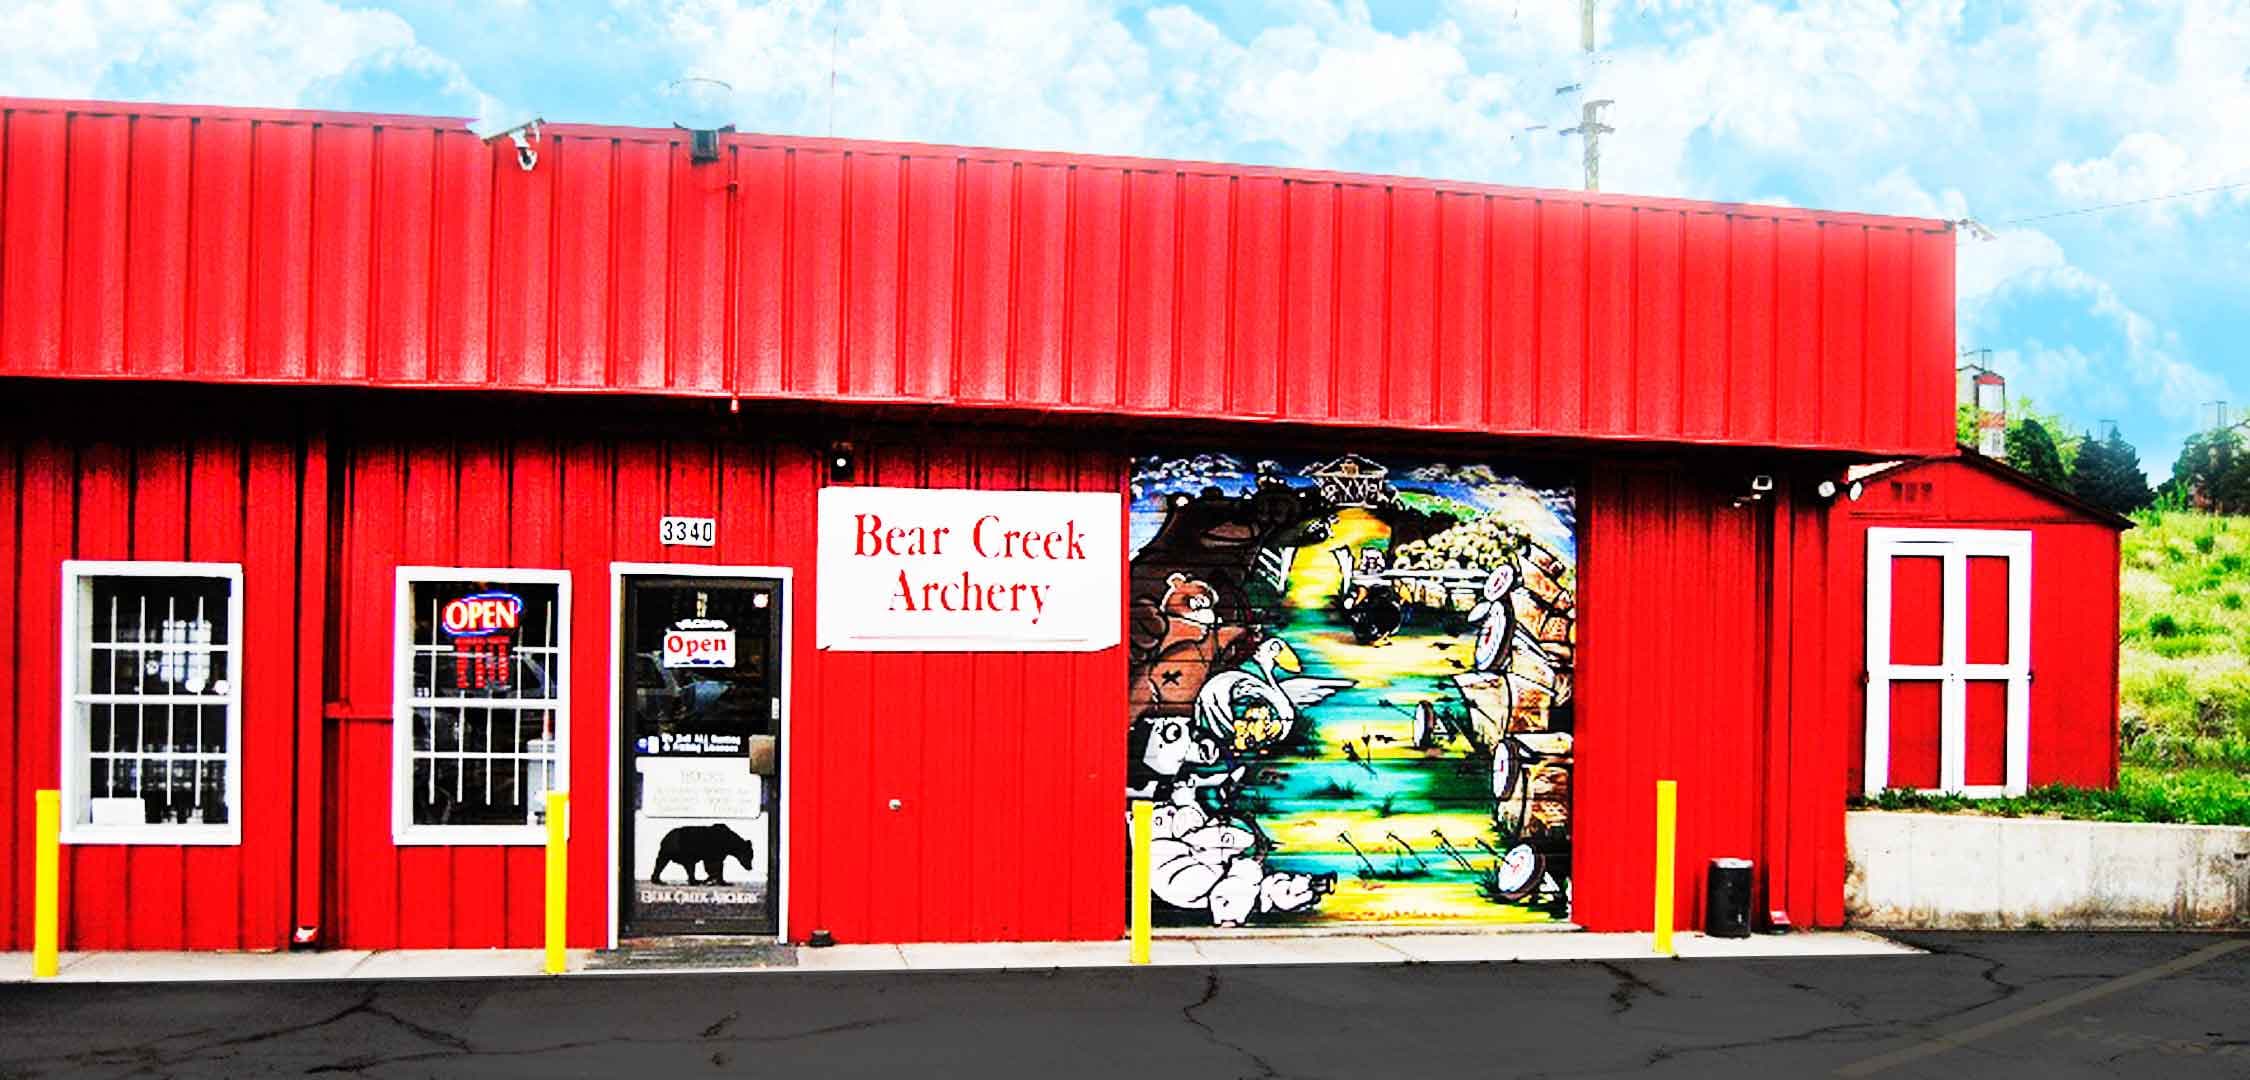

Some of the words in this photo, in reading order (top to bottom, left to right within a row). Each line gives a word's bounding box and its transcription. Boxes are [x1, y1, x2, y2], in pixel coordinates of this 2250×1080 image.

[664, 520, 712, 542] 3340
[854, 513, 949, 557] Bear
[972, 515, 1086, 560] Creek
[888, 568, 1051, 625] Archery
[445, 600, 515, 630] OPEN
[667, 635, 726, 657] Open
